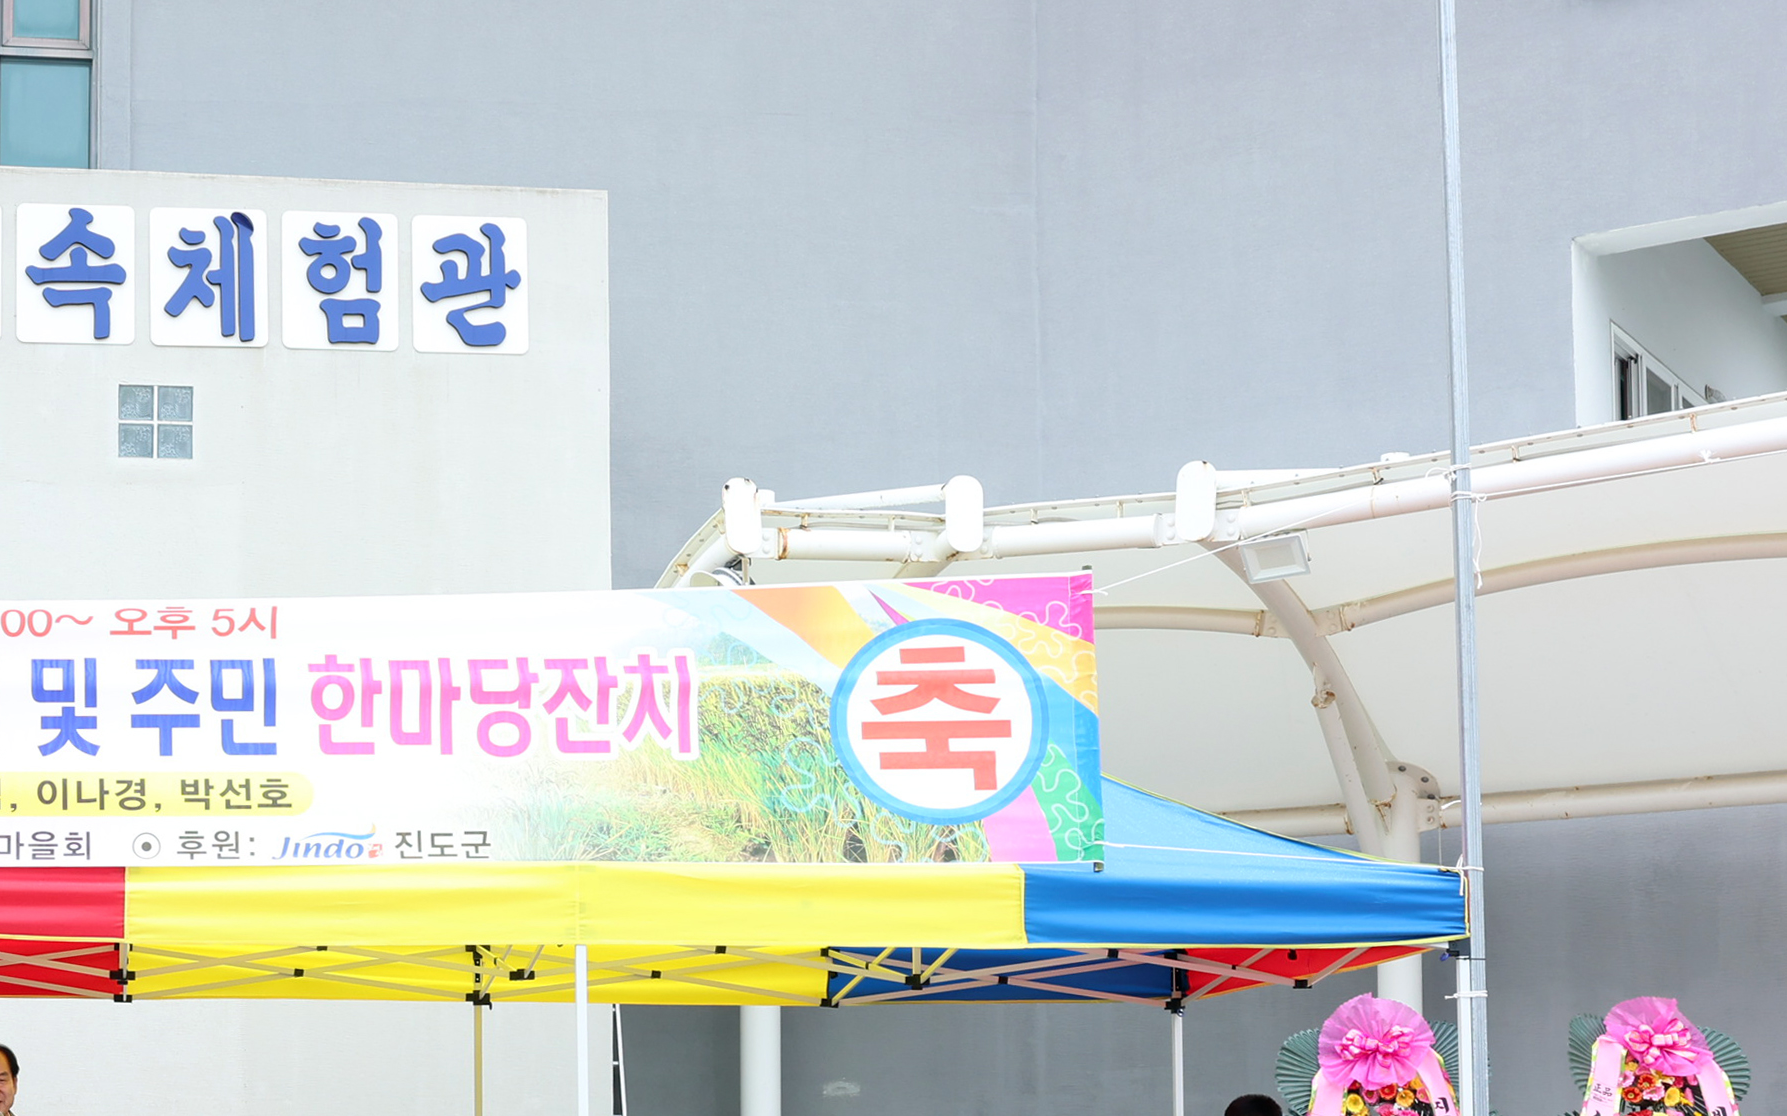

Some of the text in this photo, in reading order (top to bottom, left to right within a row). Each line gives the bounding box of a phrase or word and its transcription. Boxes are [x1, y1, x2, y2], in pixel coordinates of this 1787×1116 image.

[109, 606, 197, 640] 오후
[211, 605, 278, 640] 5시
[30, 657, 101, 757] 및
[130, 657, 278, 757] 주민
[306, 653, 693, 760] 한마당잔치
[861, 645, 1012, 792] 축
[37, 778, 161, 811] 이나경,
[181, 778, 292, 810] 박선호
[177, 830, 254, 860] 후원:
[270, 834, 366, 862] Jindo
[395, 830, 491, 859] 진도군
